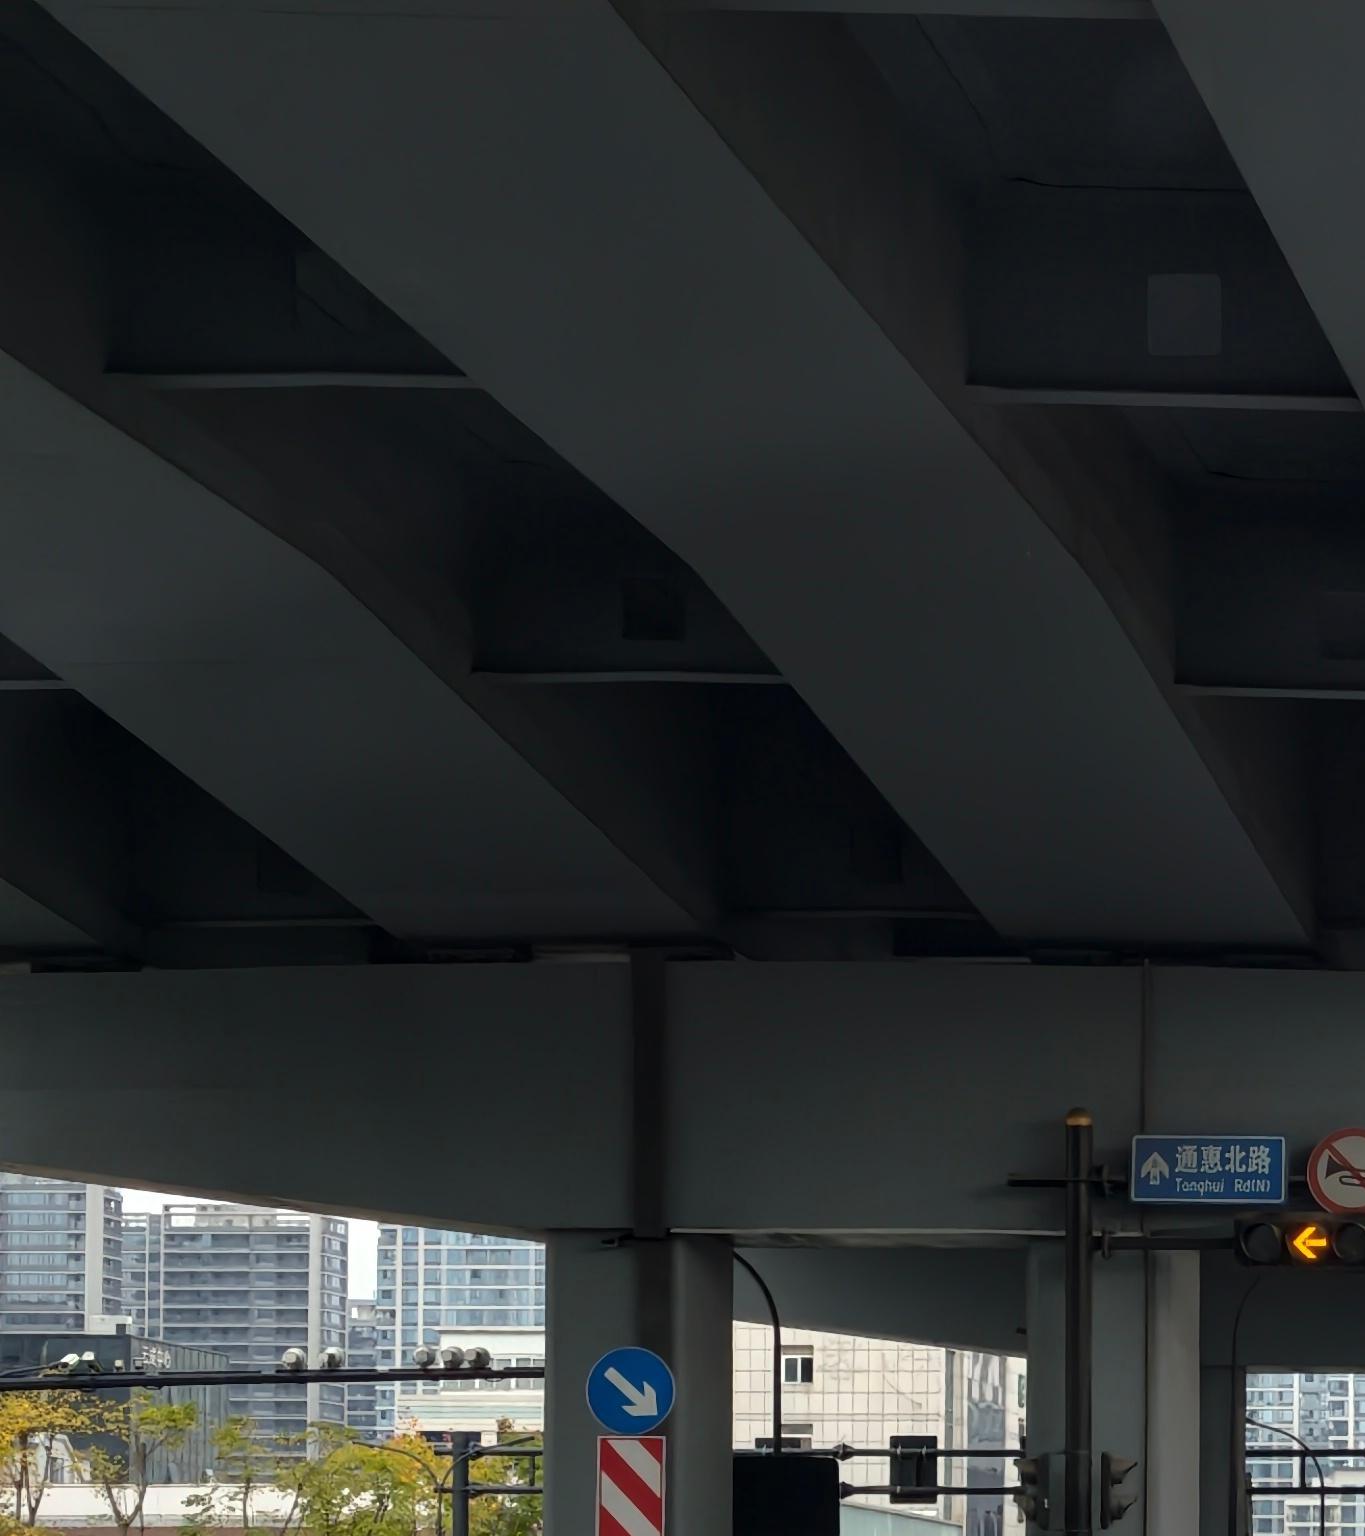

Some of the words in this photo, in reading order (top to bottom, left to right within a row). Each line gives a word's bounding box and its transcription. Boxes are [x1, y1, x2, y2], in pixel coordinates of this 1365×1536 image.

[1174, 1145, 1272, 1175] 通惠北路
[1175, 1177, 1225, 1196] Tonghui
[1234, 1178, 1271, 1194] Rd(N)
